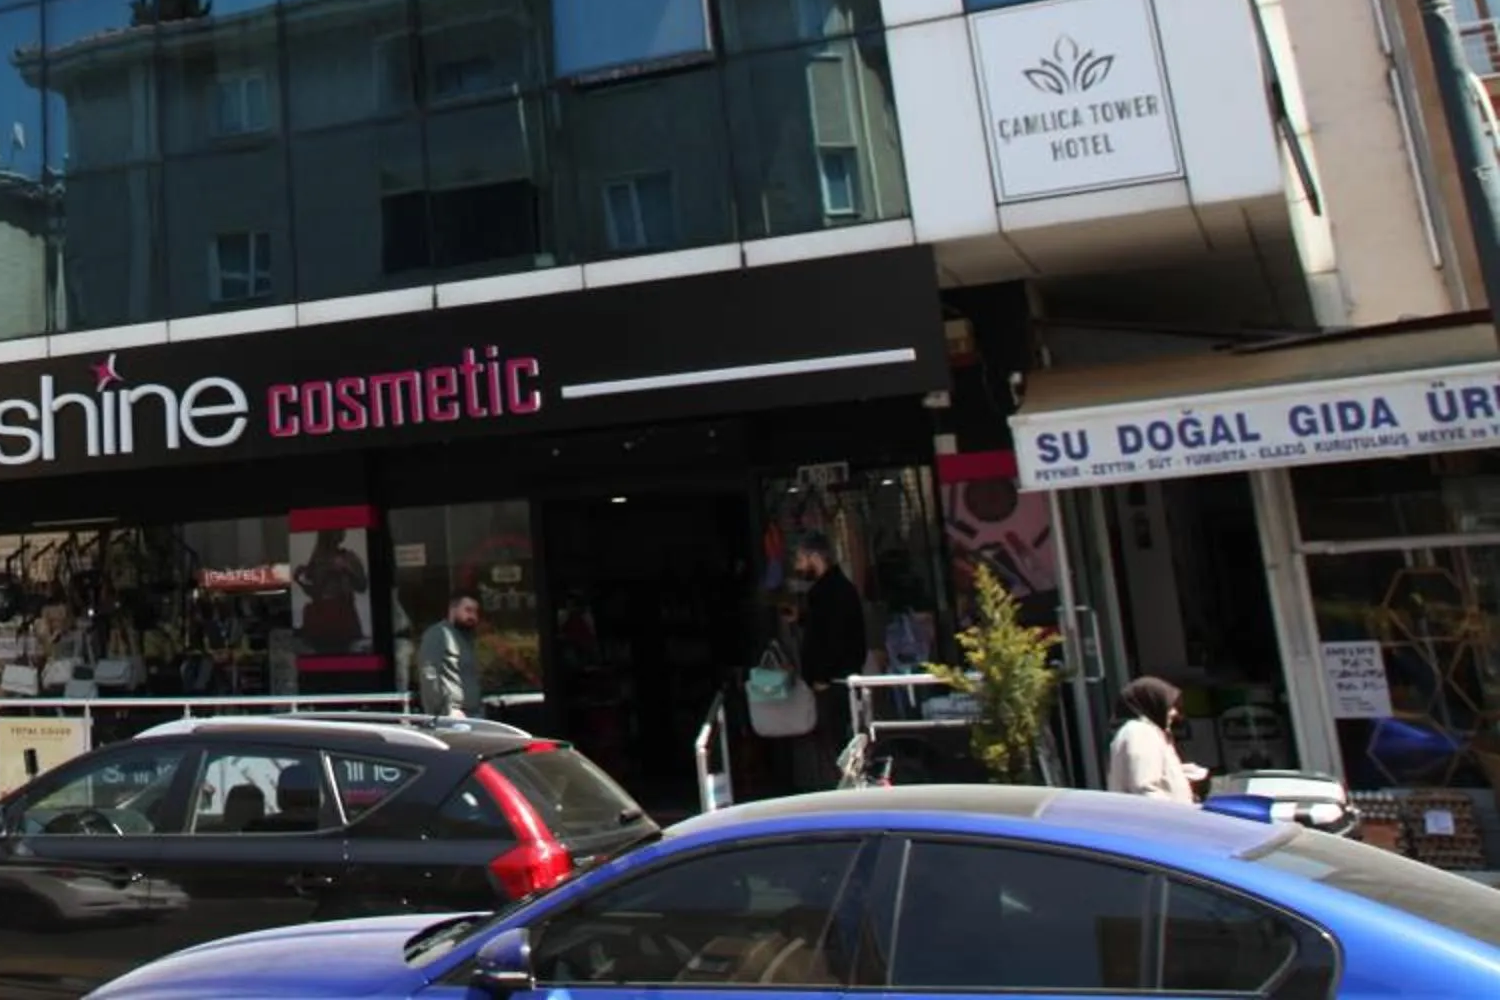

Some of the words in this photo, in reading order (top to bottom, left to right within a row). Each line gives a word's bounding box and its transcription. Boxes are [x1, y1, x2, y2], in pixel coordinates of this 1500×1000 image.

[998, 107, 1084, 144] ÇAMLICA
[1088, 95, 1158, 124] TOWER
[1050, 133, 1115, 161] HOTEL
[267, 346, 542, 438] cosmetic
[1036, 430, 1090, 464] SU
[1116, 410, 1261, 455] DOĞAL
[1288, 397, 1398, 437] GIDA
[1418, 428, 1465, 443] MEYVE
